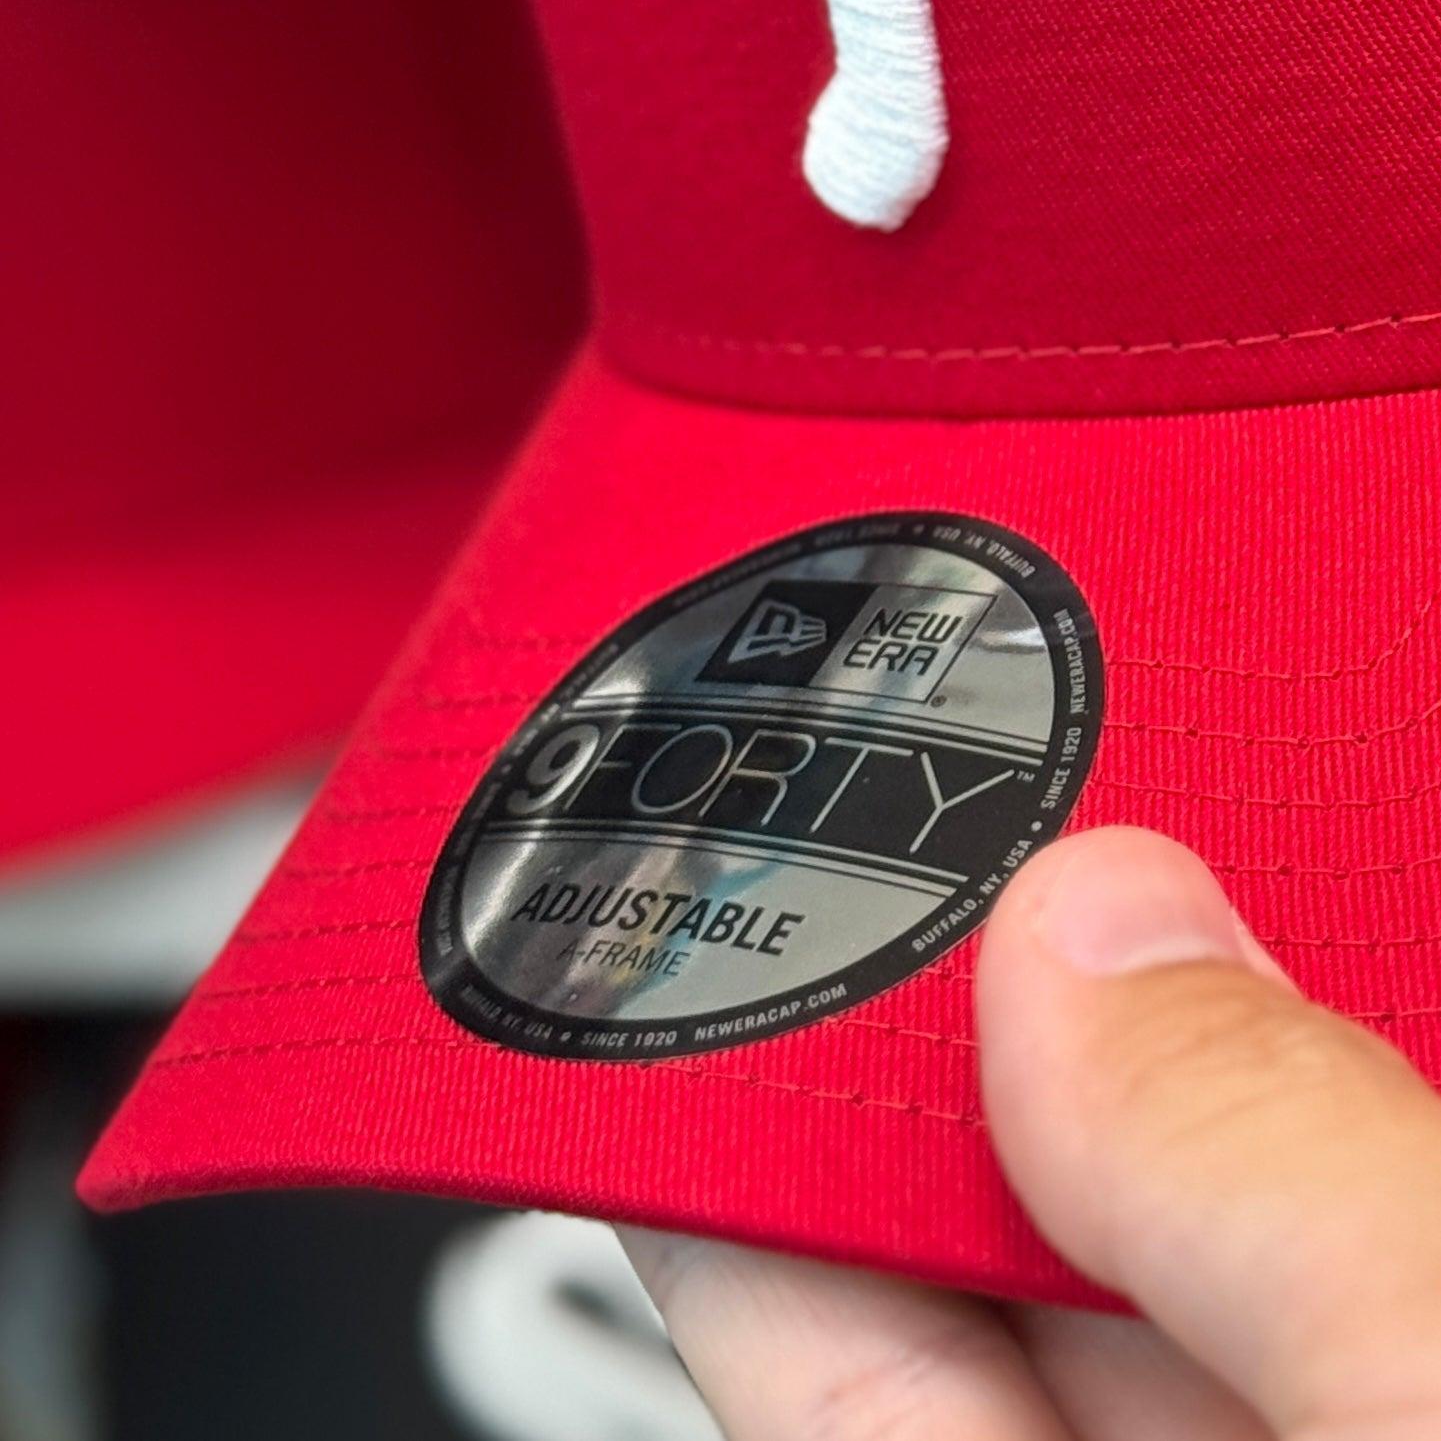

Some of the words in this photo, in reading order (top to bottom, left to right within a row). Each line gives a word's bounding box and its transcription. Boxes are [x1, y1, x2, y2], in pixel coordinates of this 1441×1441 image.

[863, 608, 963, 644] NEW
[843, 639, 940, 676] ERA
[1053, 608, 1087, 715] NEWERACAP.COM
[1061, 727, 1082, 763] 1920
[507, 723, 1016, 856] 9FORTY
[1040, 767, 1071, 809] SINCE
[1002, 839, 1033, 868] USA
[979, 872, 1009, 896] NY,
[511, 882, 806, 957] ADJUSTABLE
[911, 897, 984, 953] BUFFALO,
[556, 939, 694, 977] A-FRAME
[581, 1031, 629, 1048] SINCE
[634, 1030, 677, 1048] 1920
[695, 983, 848, 1042] NEWERACAP.COM
